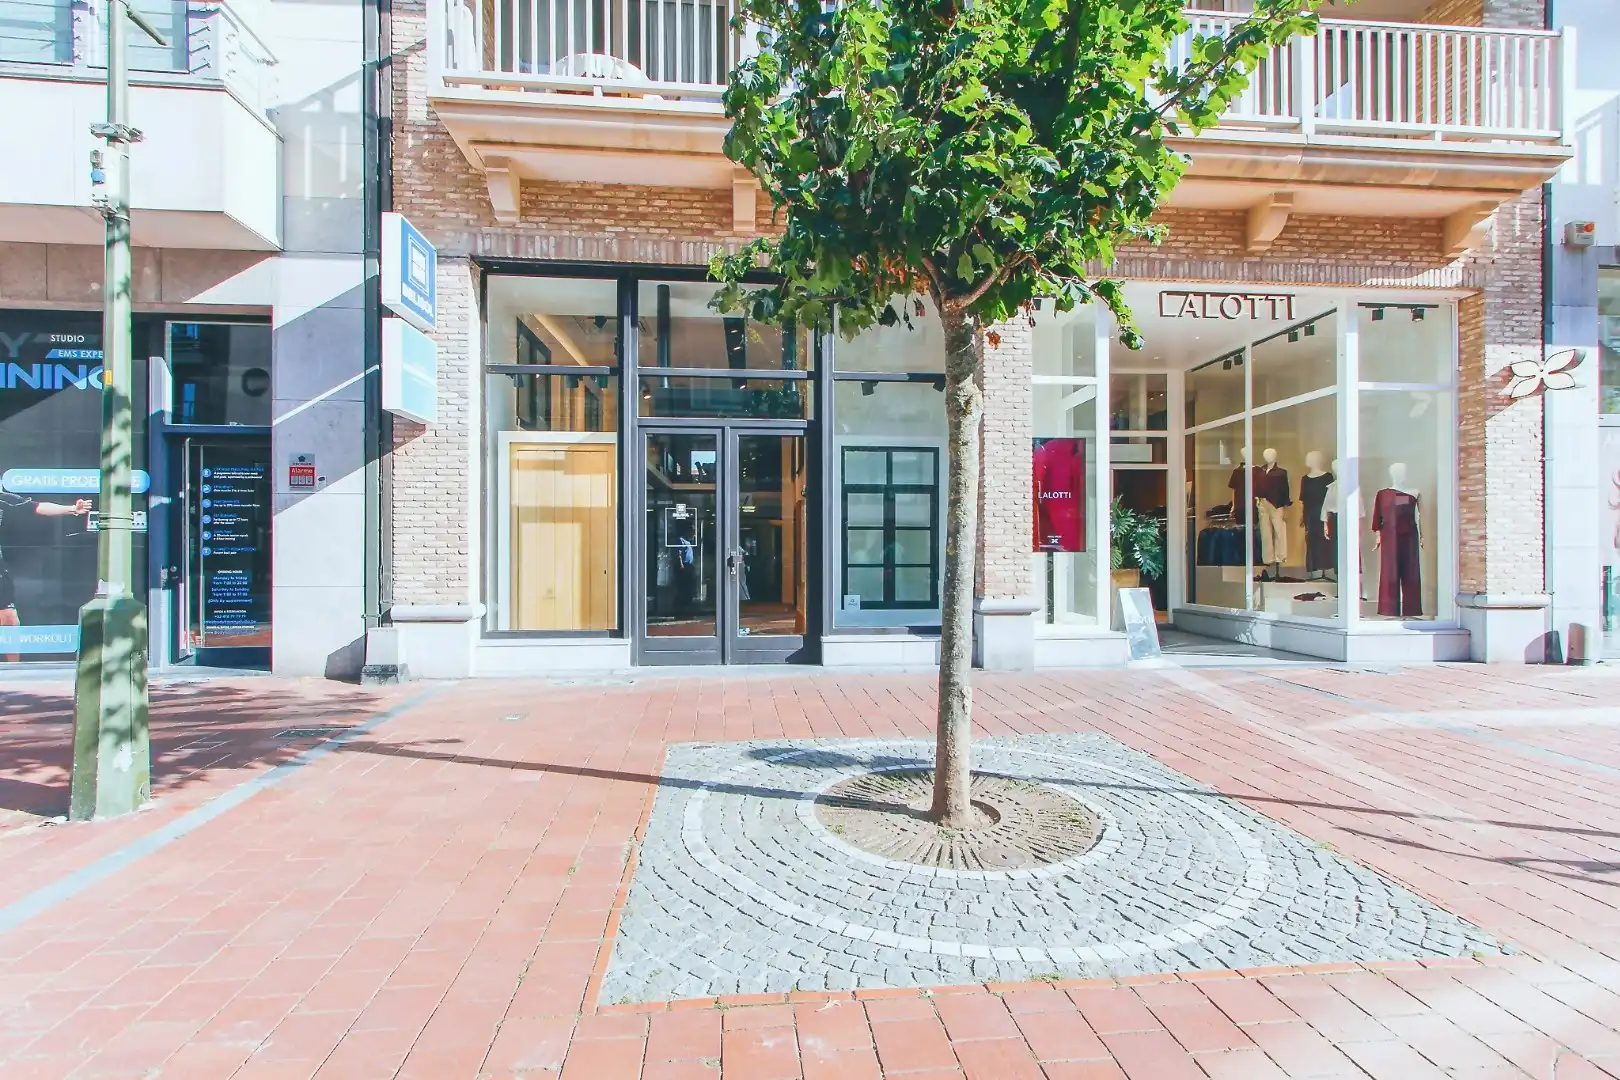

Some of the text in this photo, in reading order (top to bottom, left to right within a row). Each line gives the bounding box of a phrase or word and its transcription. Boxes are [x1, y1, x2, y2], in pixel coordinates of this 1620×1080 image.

[1159, 290, 1297, 320] LALOTTI
[50, 334, 85, 343] STUDIO
[58, 350, 80, 358] EMS
[11, 475, 58, 486] GRATIS
[1038, 491, 1072, 499] LALOTTI
